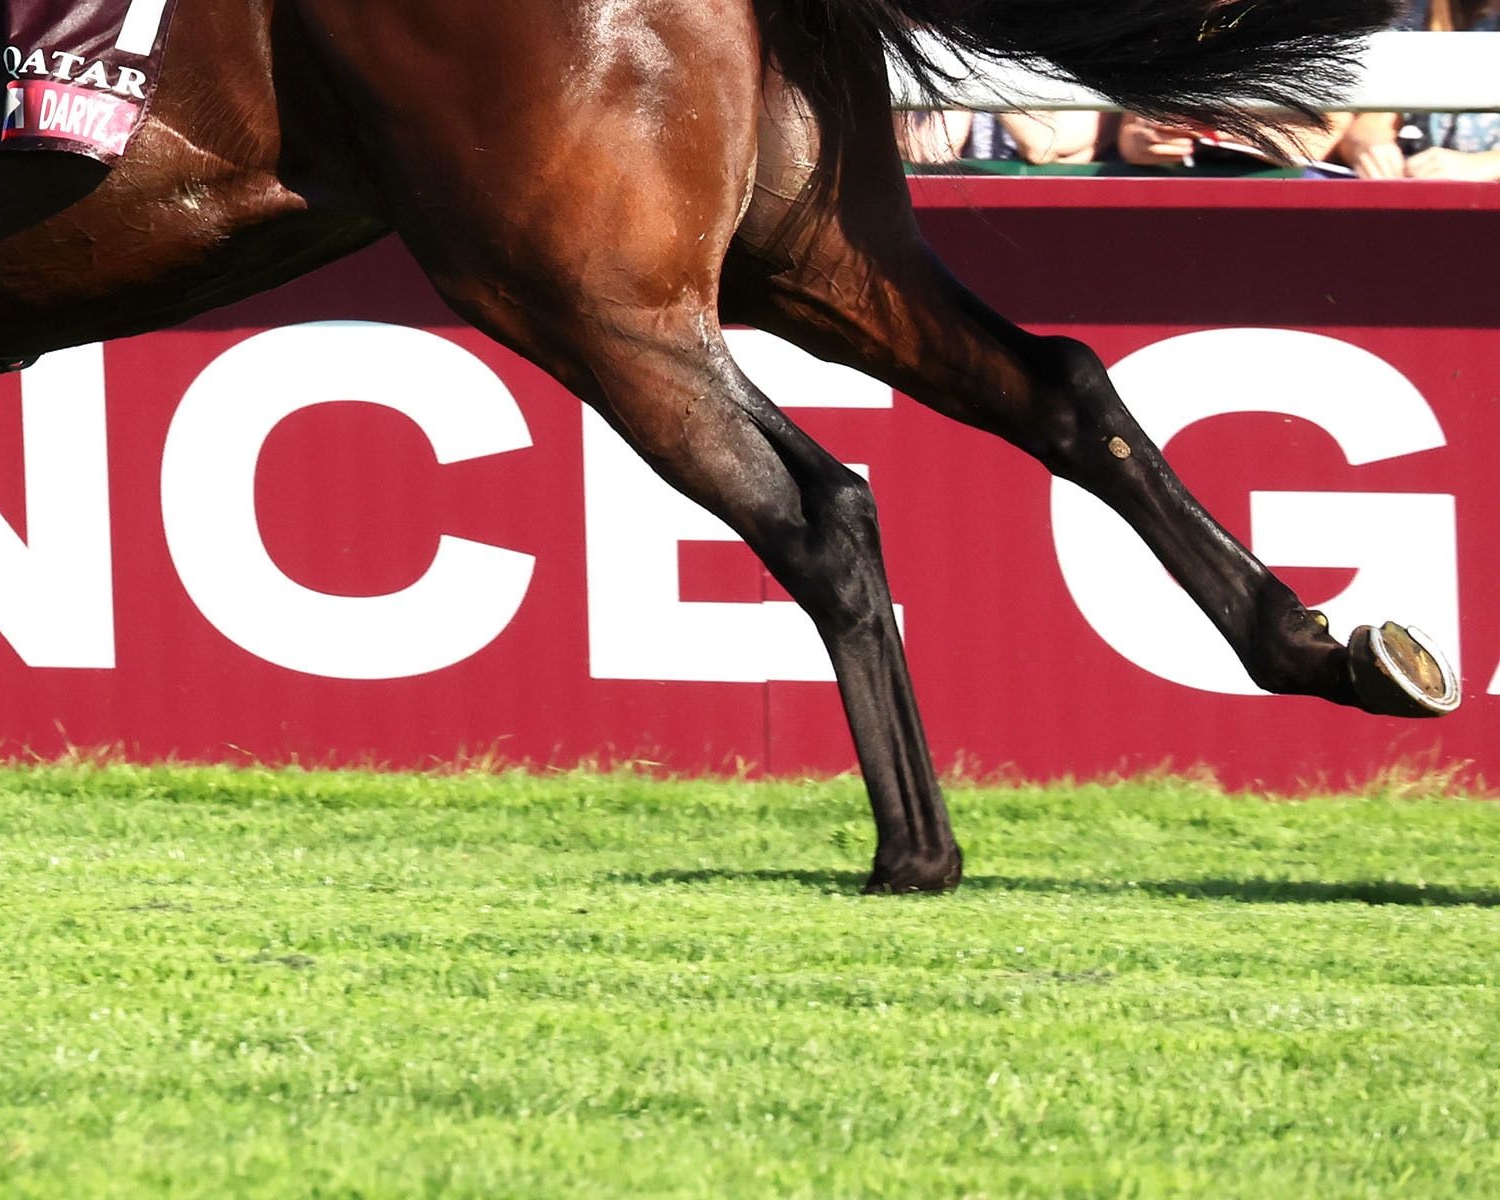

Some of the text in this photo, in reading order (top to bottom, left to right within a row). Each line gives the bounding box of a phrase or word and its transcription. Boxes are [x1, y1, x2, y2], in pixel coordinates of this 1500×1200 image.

[3, 46, 147, 100] QATAR
[38, 89, 116, 142] DARYZ
[1051, 328, 1500, 696] G
